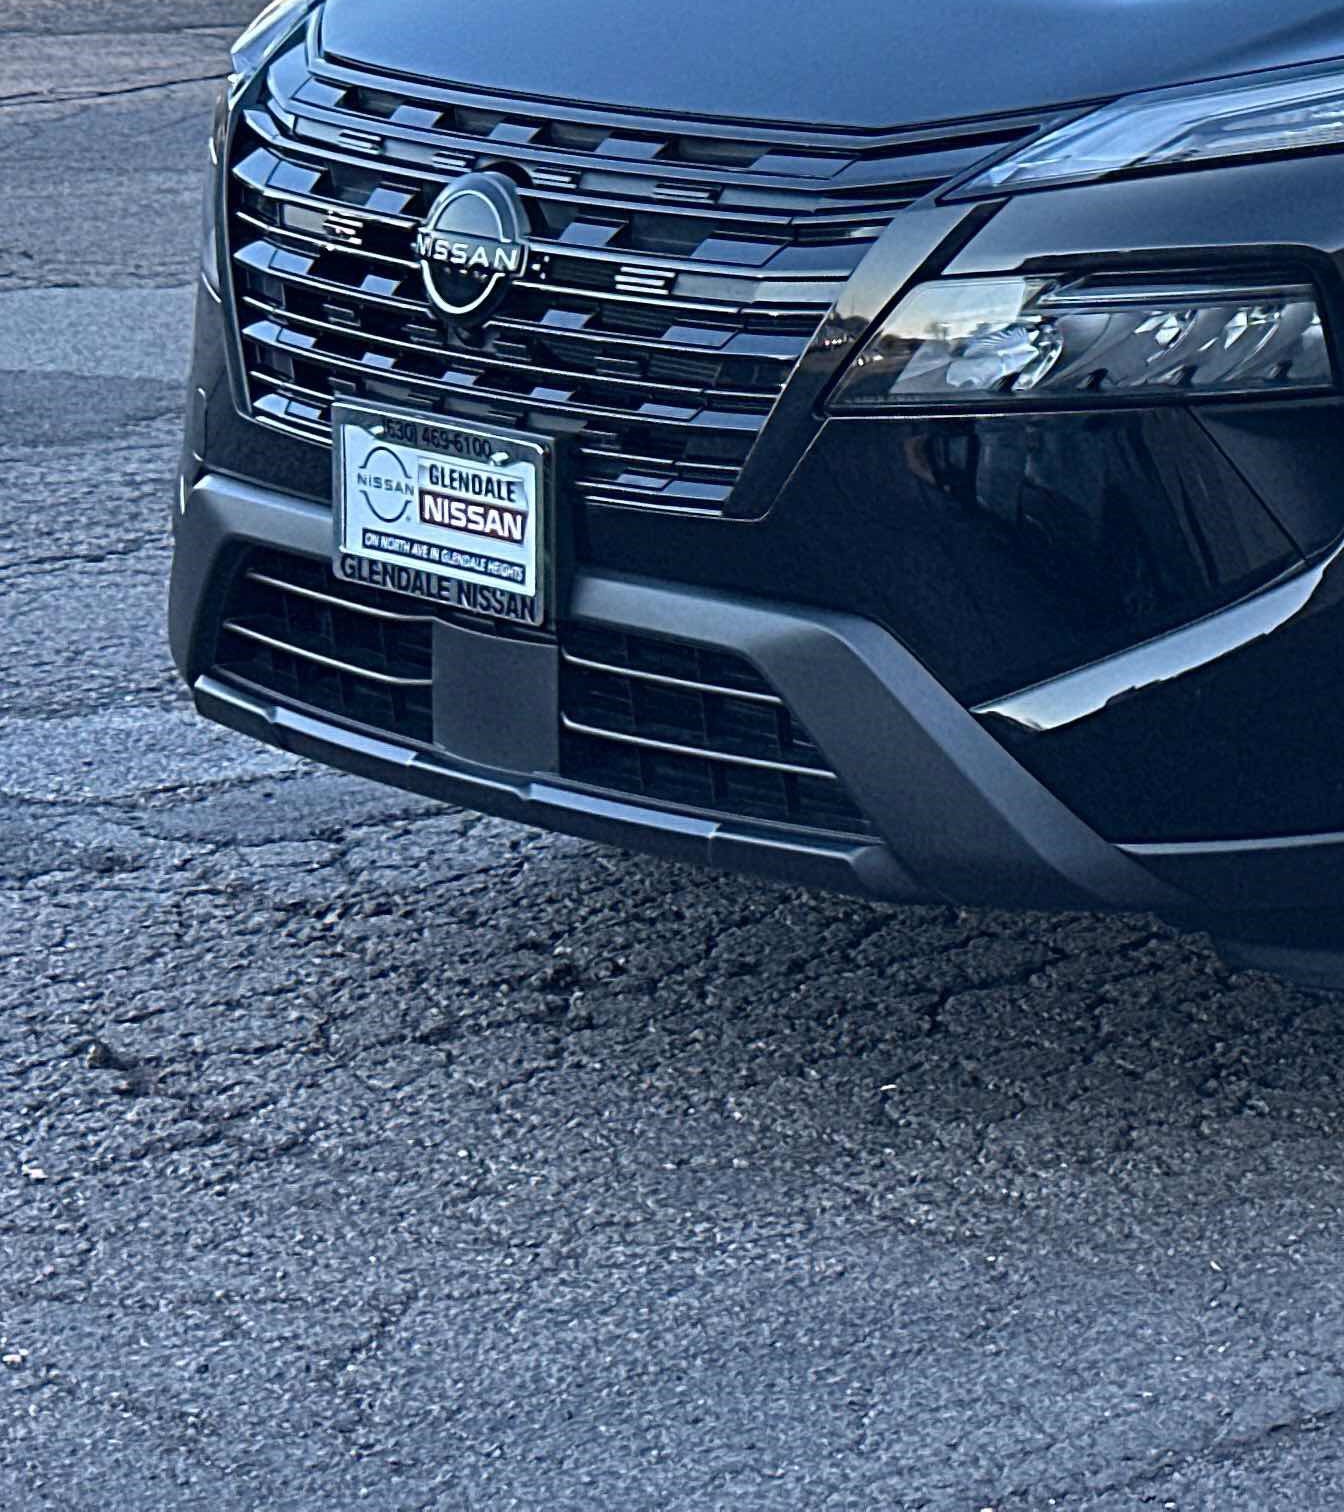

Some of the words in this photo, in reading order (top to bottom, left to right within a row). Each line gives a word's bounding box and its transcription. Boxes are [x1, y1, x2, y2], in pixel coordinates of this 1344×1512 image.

[415, 233, 519, 271] NISSAN
[421, 428, 492, 457] 469-6100
[356, 471, 415, 497] NISSAN
[428, 463, 517, 503] GLENDALE
[423, 493, 523, 540] NISSAN
[364, 532, 379, 546] ON
[381, 536, 411, 553] NORTH
[411, 541, 429, 558] AVE
[430, 546, 440, 561] IN
[441, 549, 488, 572] GLENDALE
[487, 559, 524, 581] HEIGHTS
[340, 554, 451, 597] GLENDALE
[457, 580, 537, 624] NISSAN
